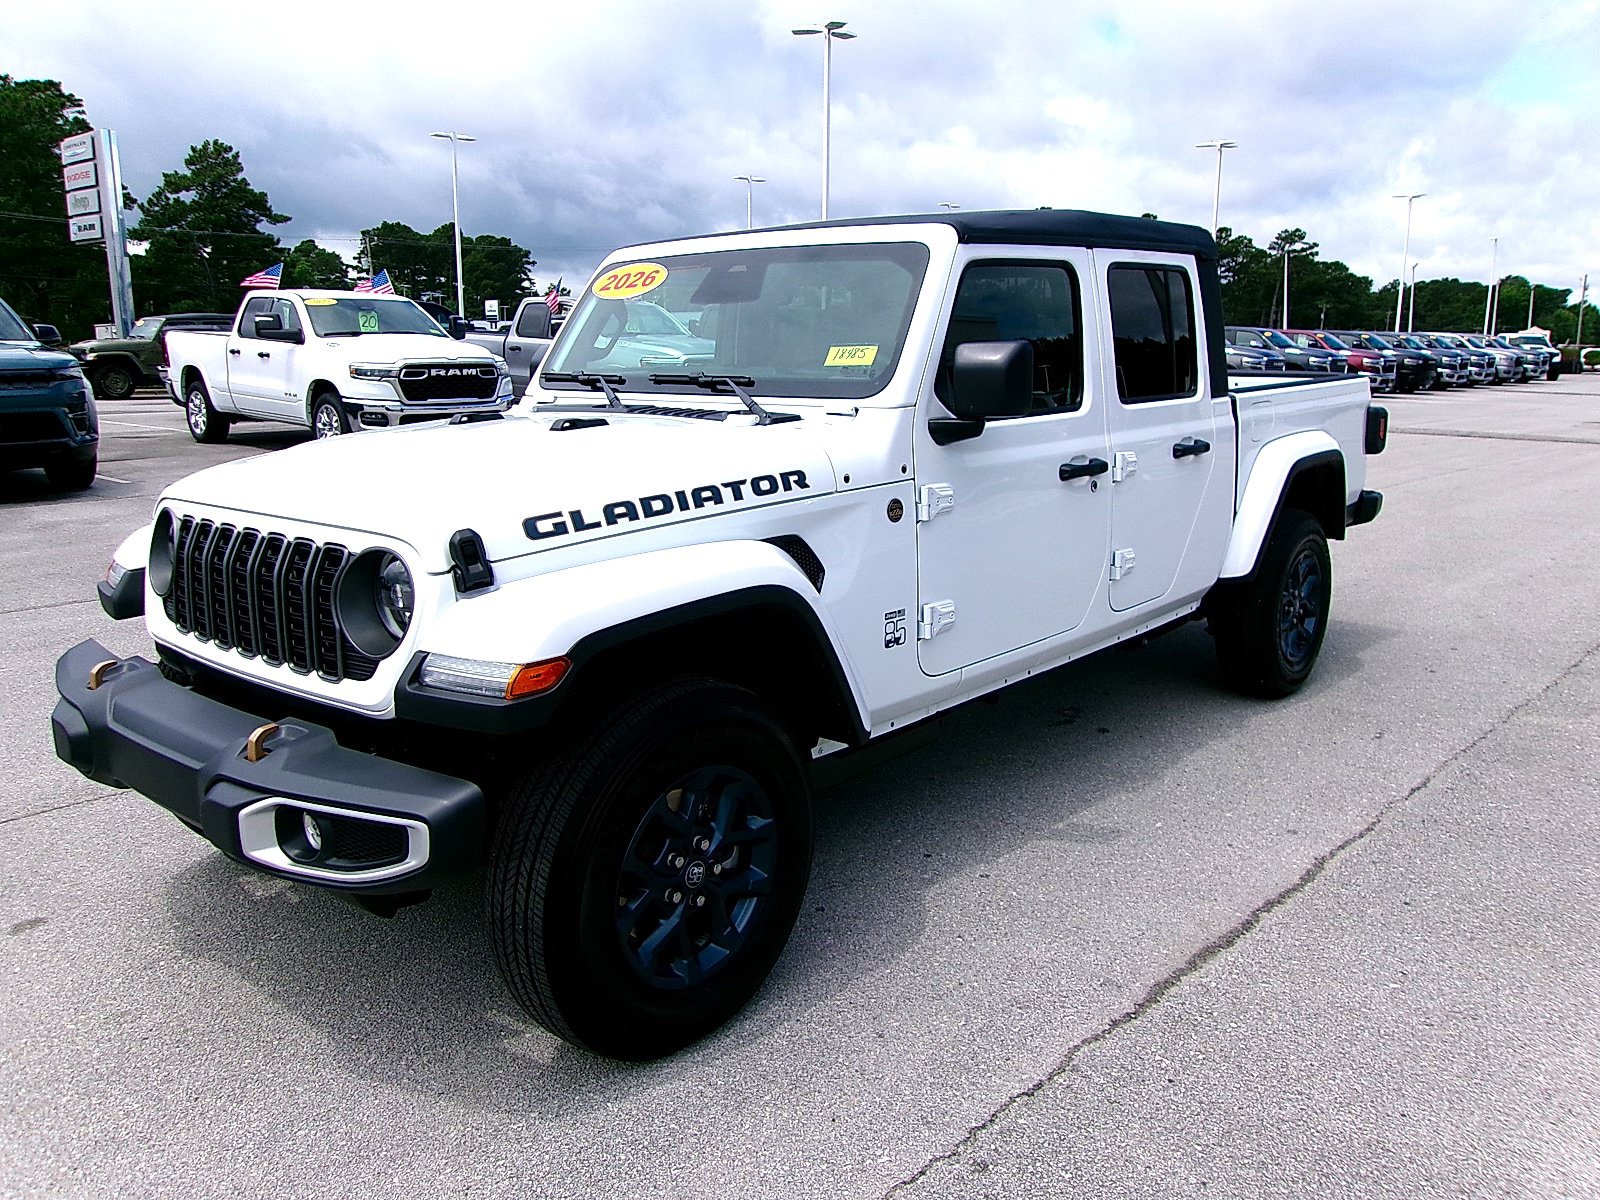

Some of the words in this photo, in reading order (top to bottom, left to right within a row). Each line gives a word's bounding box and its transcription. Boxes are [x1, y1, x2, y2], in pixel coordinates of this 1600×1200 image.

[67, 170, 91, 182] DODGE
[77, 223, 96, 233] RAM
[599, 269, 660, 291] 2026
[360, 314, 376, 328] 20
[833, 347, 870, 361] 18485
[430, 368, 477, 376] RAM
[521, 469, 811, 541] GLADIATOR
[885, 617, 906, 648] 85
